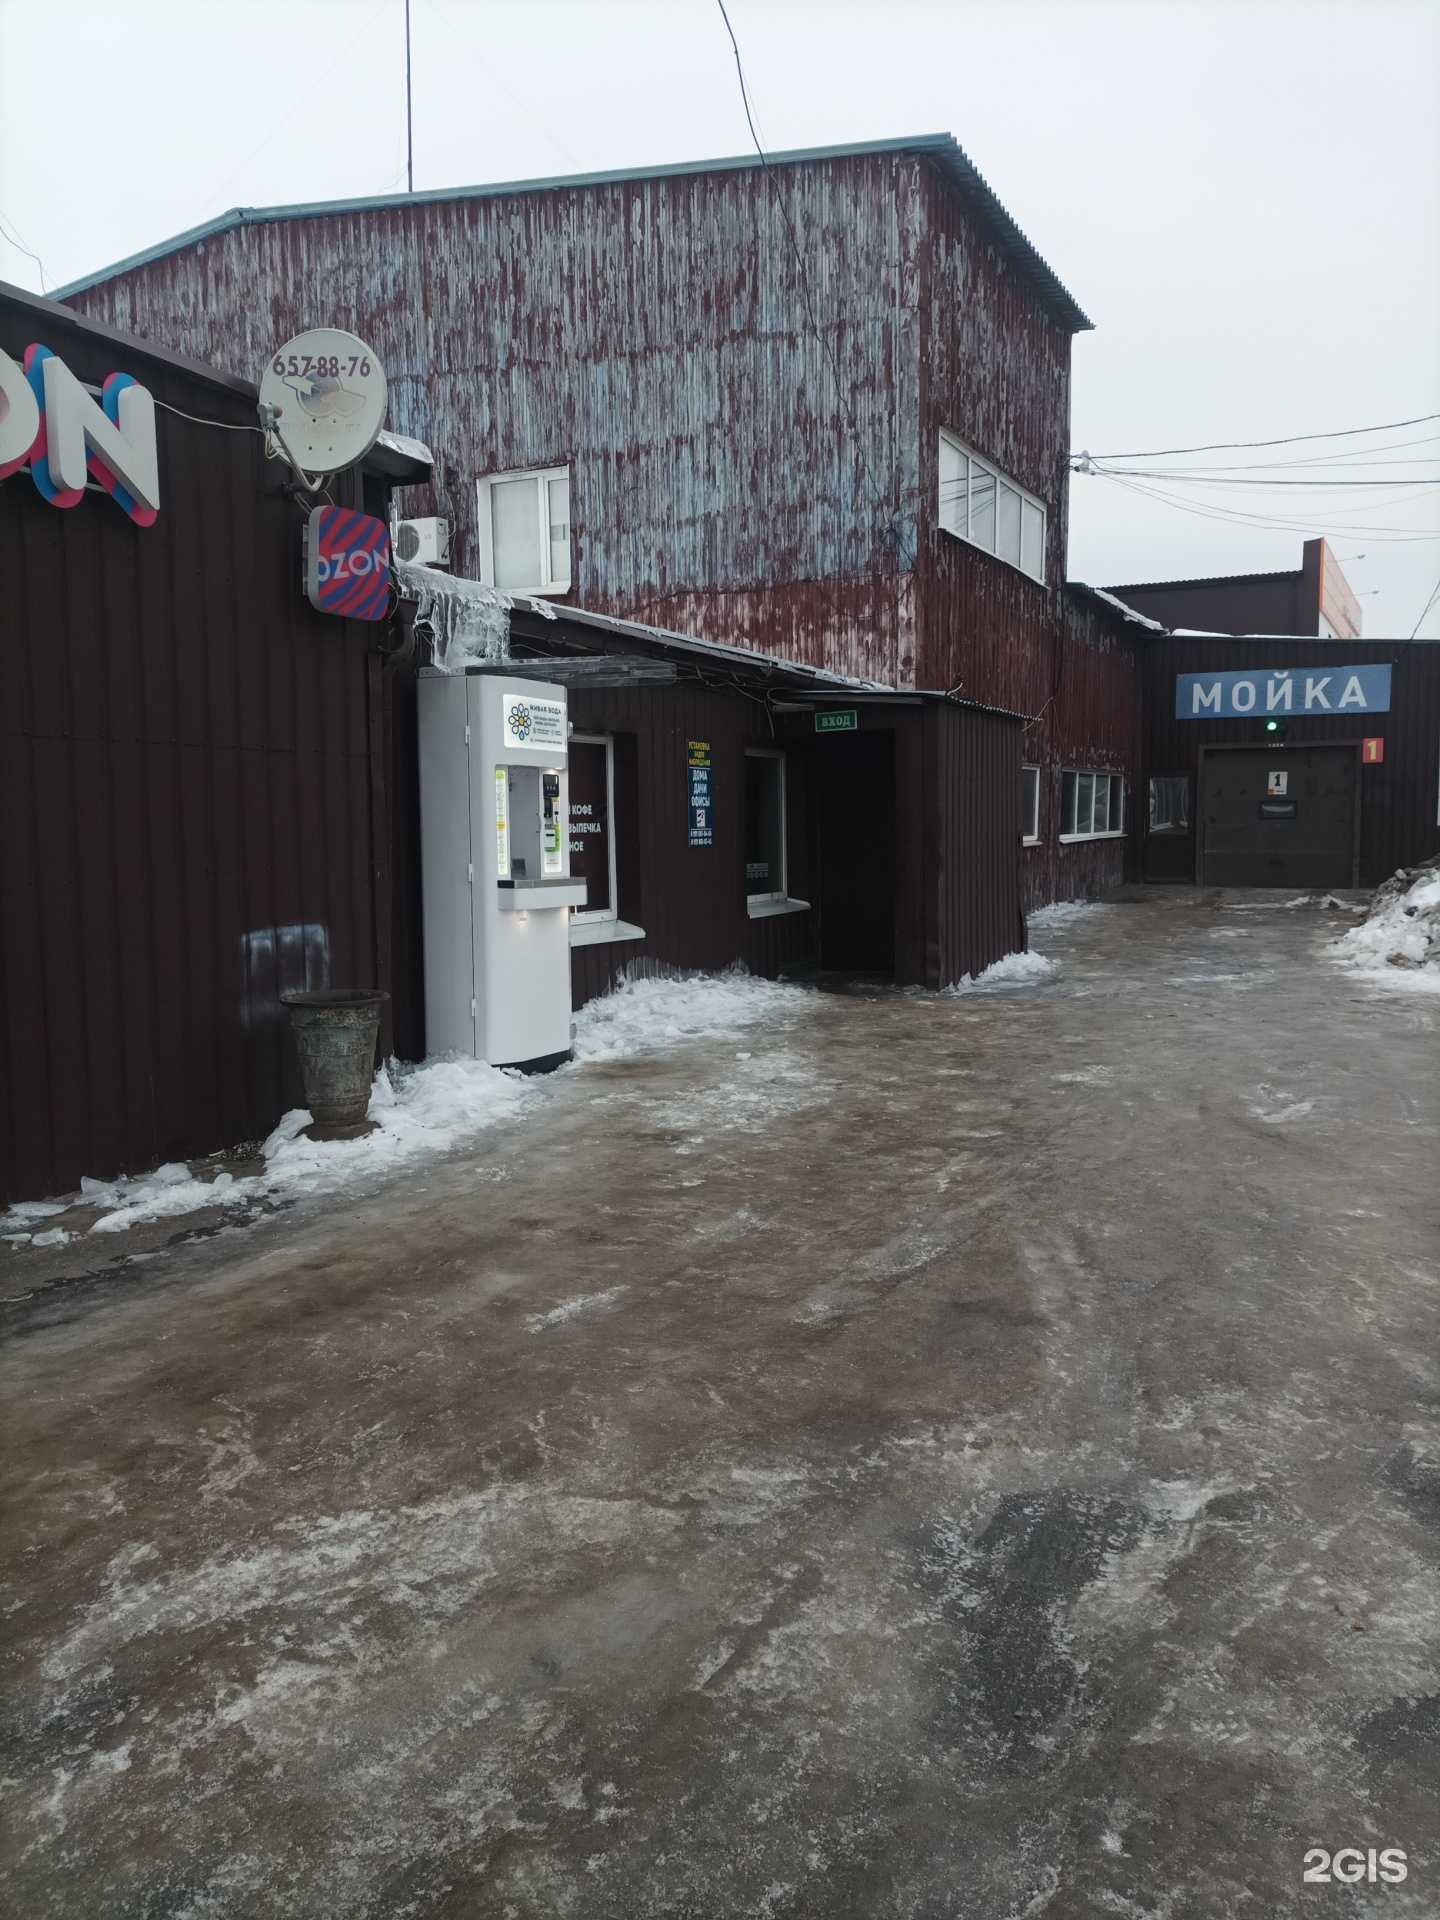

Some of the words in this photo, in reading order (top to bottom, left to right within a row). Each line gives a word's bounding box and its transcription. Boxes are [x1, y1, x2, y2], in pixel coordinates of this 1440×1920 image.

[272, 354, 371, 378] 657-88-76
[1192, 671, 1368, 714] МОЙКА
[822, 715, 851, 728] ВХОД
[1367, 740, 1377, 760] 1
[693, 769, 708, 781] ДОМА
[1275, 773, 1281, 787] 1
[693, 783, 707, 795] ДАЧИ
[691, 795, 711, 807] ОФИСЫ
[572, 804, 592, 815] КОФЕ
